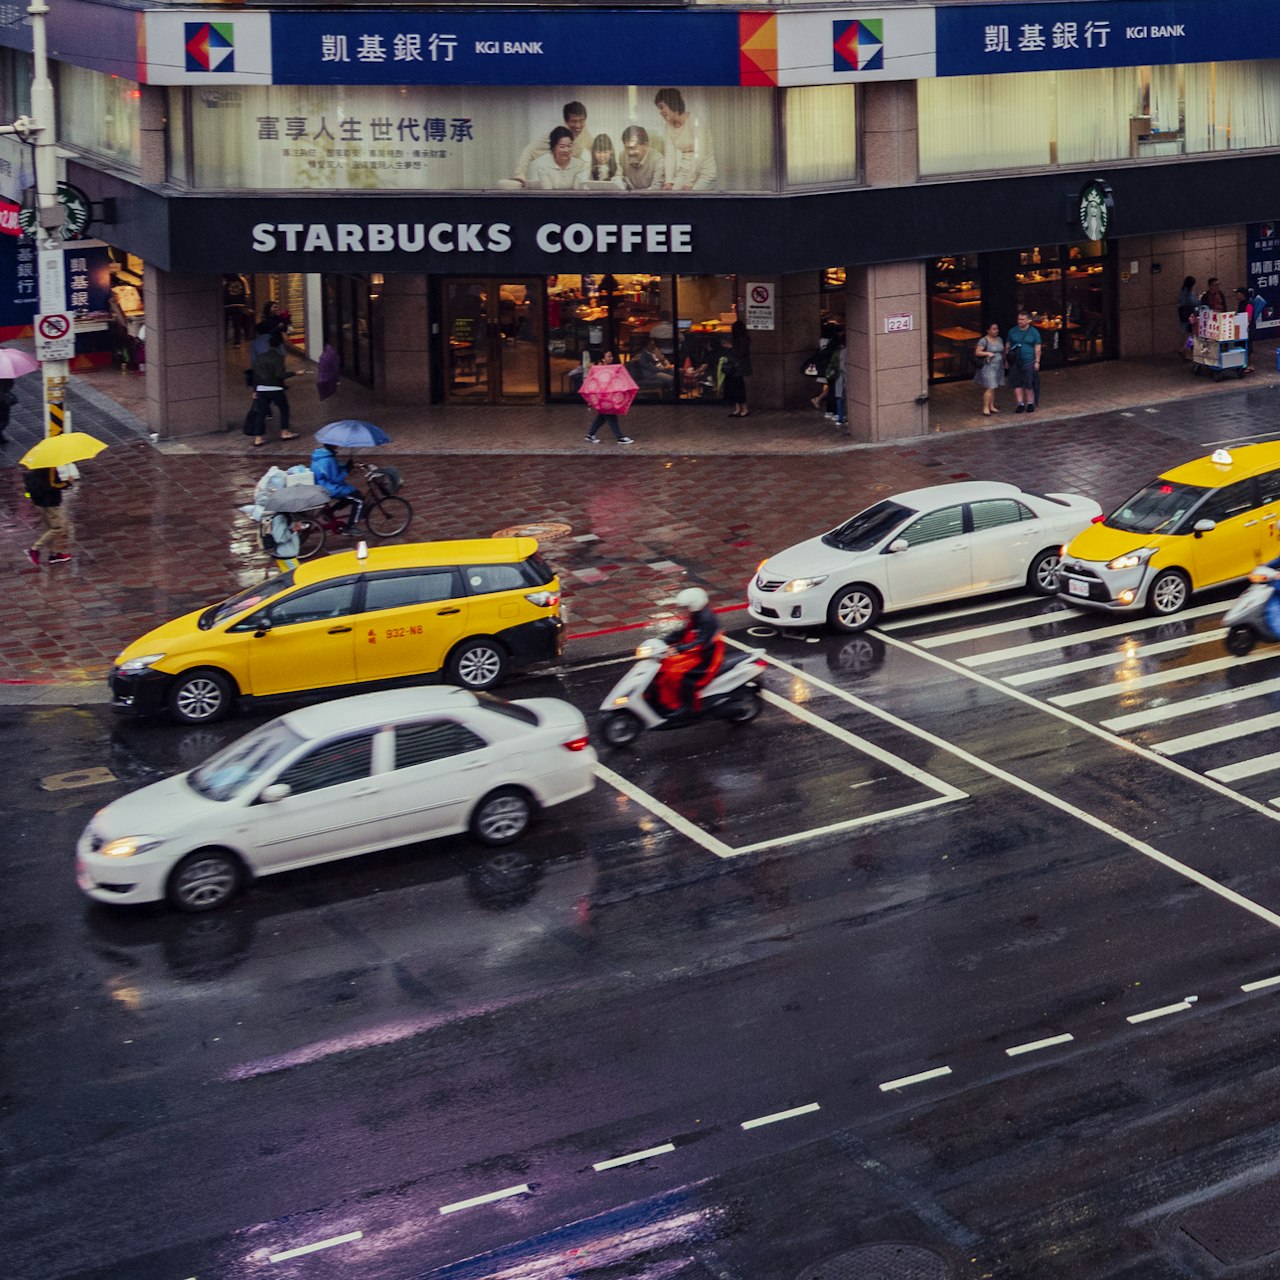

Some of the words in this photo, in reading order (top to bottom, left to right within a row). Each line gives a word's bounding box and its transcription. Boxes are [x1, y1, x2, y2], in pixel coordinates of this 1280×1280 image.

[321, 32, 459, 62] 凱基銀行
[475, 42, 500, 54] KGI
[503, 42, 543, 55] BANK
[984, 21, 1111, 53] 凱基銀行
[1126, 26, 1148, 39] KGI
[1151, 24, 1186, 39] BANK
[256, 115, 364, 142] 富享人生
[369, 115, 474, 143] 世代傳承
[252, 222, 511, 253] STARBUCKS
[536, 223, 692, 253] COFFEE
[1256, 275, 1279, 288] 右轉
[889, 319, 909, 330] 224
